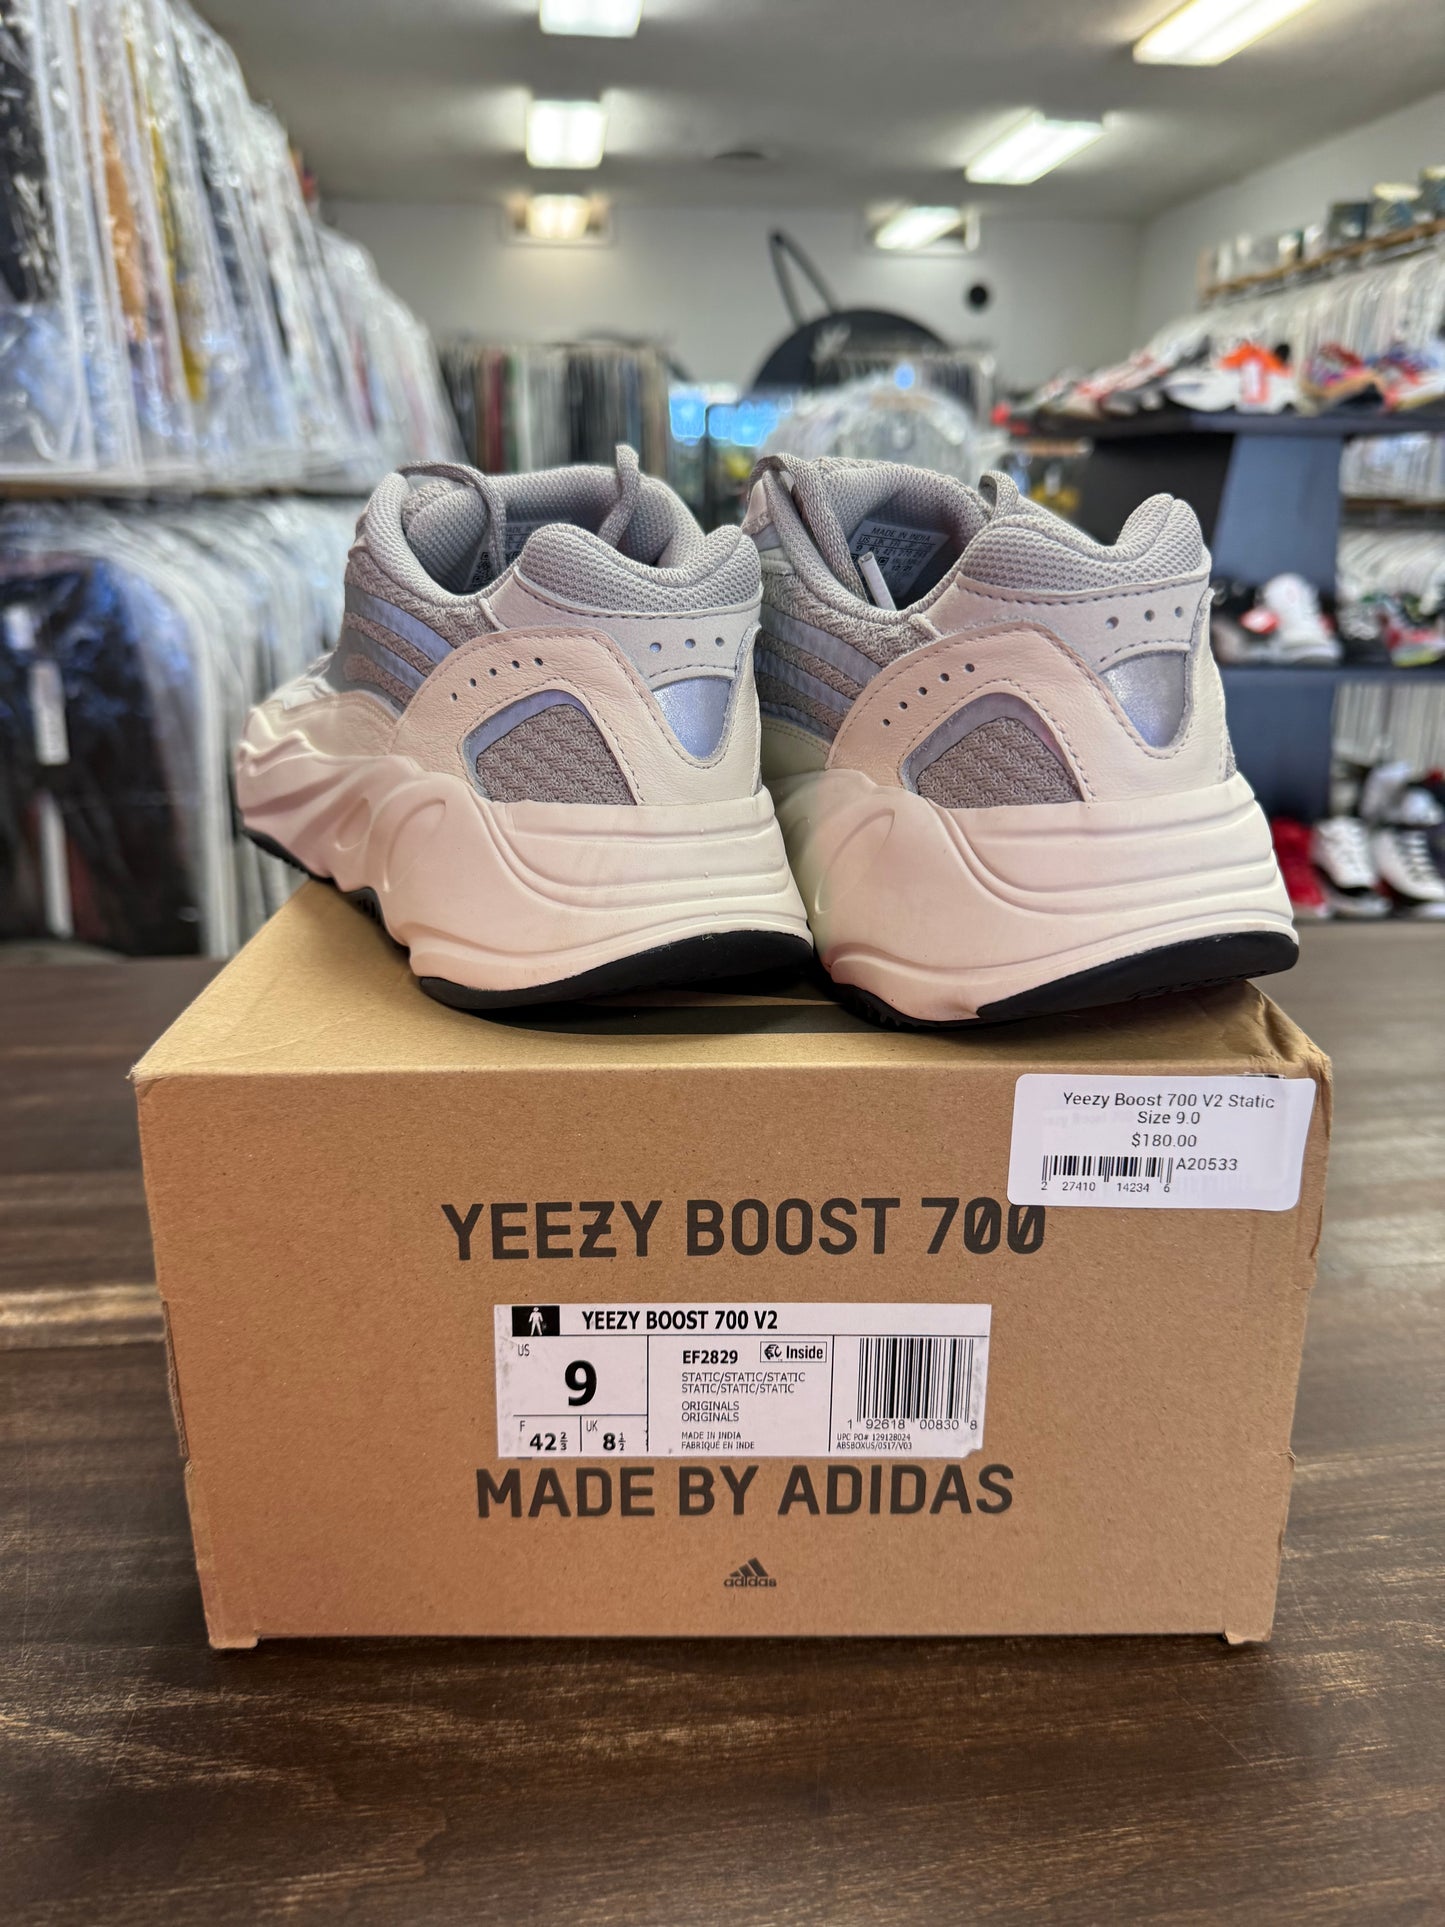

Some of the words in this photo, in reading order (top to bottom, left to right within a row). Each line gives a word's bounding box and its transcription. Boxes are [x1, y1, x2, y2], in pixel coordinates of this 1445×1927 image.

[871, 527, 896, 537] MADE
[858, 536, 871, 544] US
[856, 544, 863, 552] 9
[1063, 1092, 1110, 1109] Yeezy
[1114, 1092, 1162, 1107] Boost
[1167, 1093, 1197, 1108] 700
[1202, 1093, 1223, 1108] V2
[1228, 1093, 1276, 1109] Static
[1137, 1110, 1171, 1125] Size
[1176, 1111, 1201, 1125] 9.0
[1131, 1131, 1198, 1148] $180.00
[1176, 1157, 1238, 1171] A20533
[1040, 1181, 1048, 1191] 2
[1062, 1182, 1096, 1192] 27410
[1117, 1183, 1150, 1193] 14234
[1163, 1183, 1170, 1193] 6
[441, 1200, 663, 1261] YEEZY
[686, 1197, 901, 1257] BOOST
[921, 1196, 1046, 1255] 700
[582, 1310, 641, 1330] YEEZY
[646, 1310, 709, 1330] BOOST
[714, 1310, 749, 1330] 700
[754, 1310, 778, 1330] V2
[517, 1343, 530, 1357] US
[786, 1345, 823, 1360] Inside
[682, 1350, 739, 1365] EF2829
[564, 1359, 598, 1406] 9
[681, 1371, 806, 1387] STATIC/STATIC/STATIC
[681, 1383, 795, 1395] STATIC/STATIC/STATIC
[681, 1401, 740, 1411] ORIGINALS
[681, 1412, 740, 1422] ORIGINALS
[519, 1420, 526, 1432] F
[585, 1421, 598, 1432] UK
[847, 1419, 853, 1430] 1
[865, 1420, 906, 1430] 92618
[919, 1419, 960, 1430] 00830
[969, 1420, 978, 1430] 8
[681, 1431, 704, 1440] MADE
[706, 1431, 716, 1440] IN
[718, 1431, 742, 1440] INDIA
[836, 1433, 851, 1441] UPC
[853, 1433, 869, 1441] PO#
[872, 1433, 911, 1441] 129128024
[681, 1440, 721, 1451] FABRIQUÉ
[722, 1441, 733, 1450] EN
[736, 1441, 755, 1450] INDE
[476, 1467, 656, 1518] MADE
[678, 1464, 760, 1516] BY
[777, 1463, 1015, 1516] ADIDAS
[723, 1575, 778, 1588] adidas
